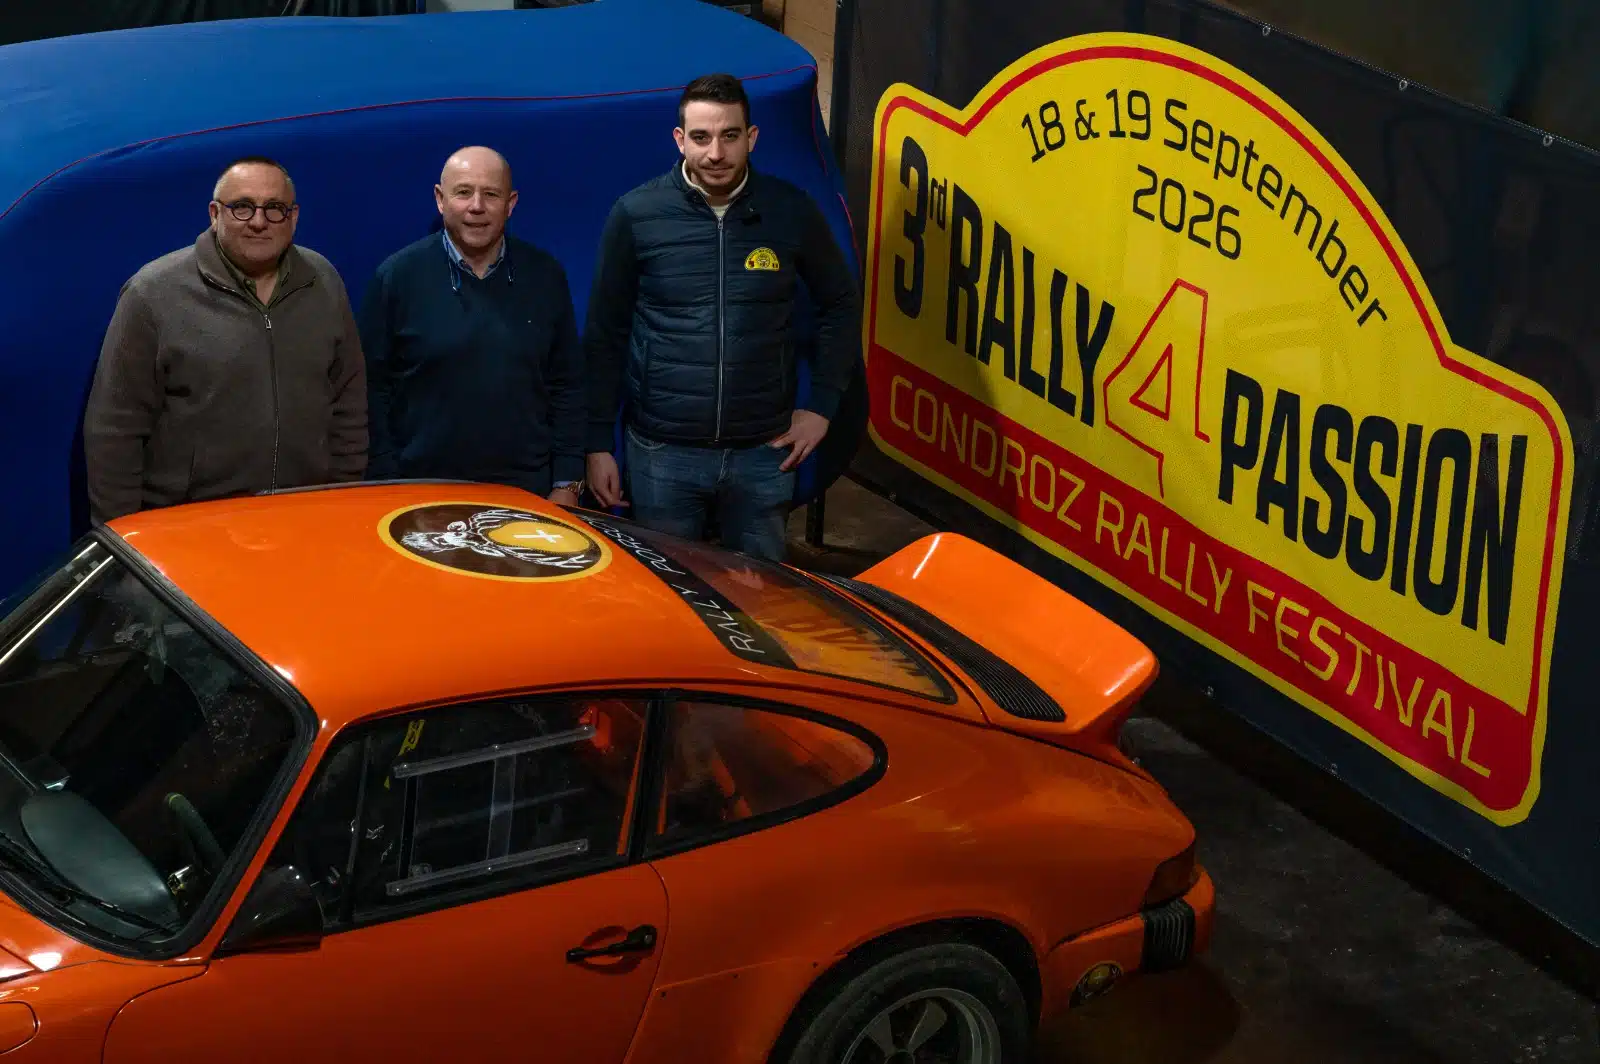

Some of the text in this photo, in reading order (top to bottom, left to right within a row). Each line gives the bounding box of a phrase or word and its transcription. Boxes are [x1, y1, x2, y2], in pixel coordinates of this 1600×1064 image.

[1021, 88, 1388, 327] 18 & 19 September
[1133, 165, 1242, 260] 2026
[894, 135, 1528, 645] 3rd RALLY 4 PASSION
[580, 515, 765, 654] RALLY PORSC
[890, 375, 1492, 779] CONDROZ RALLY FESTIVAL
